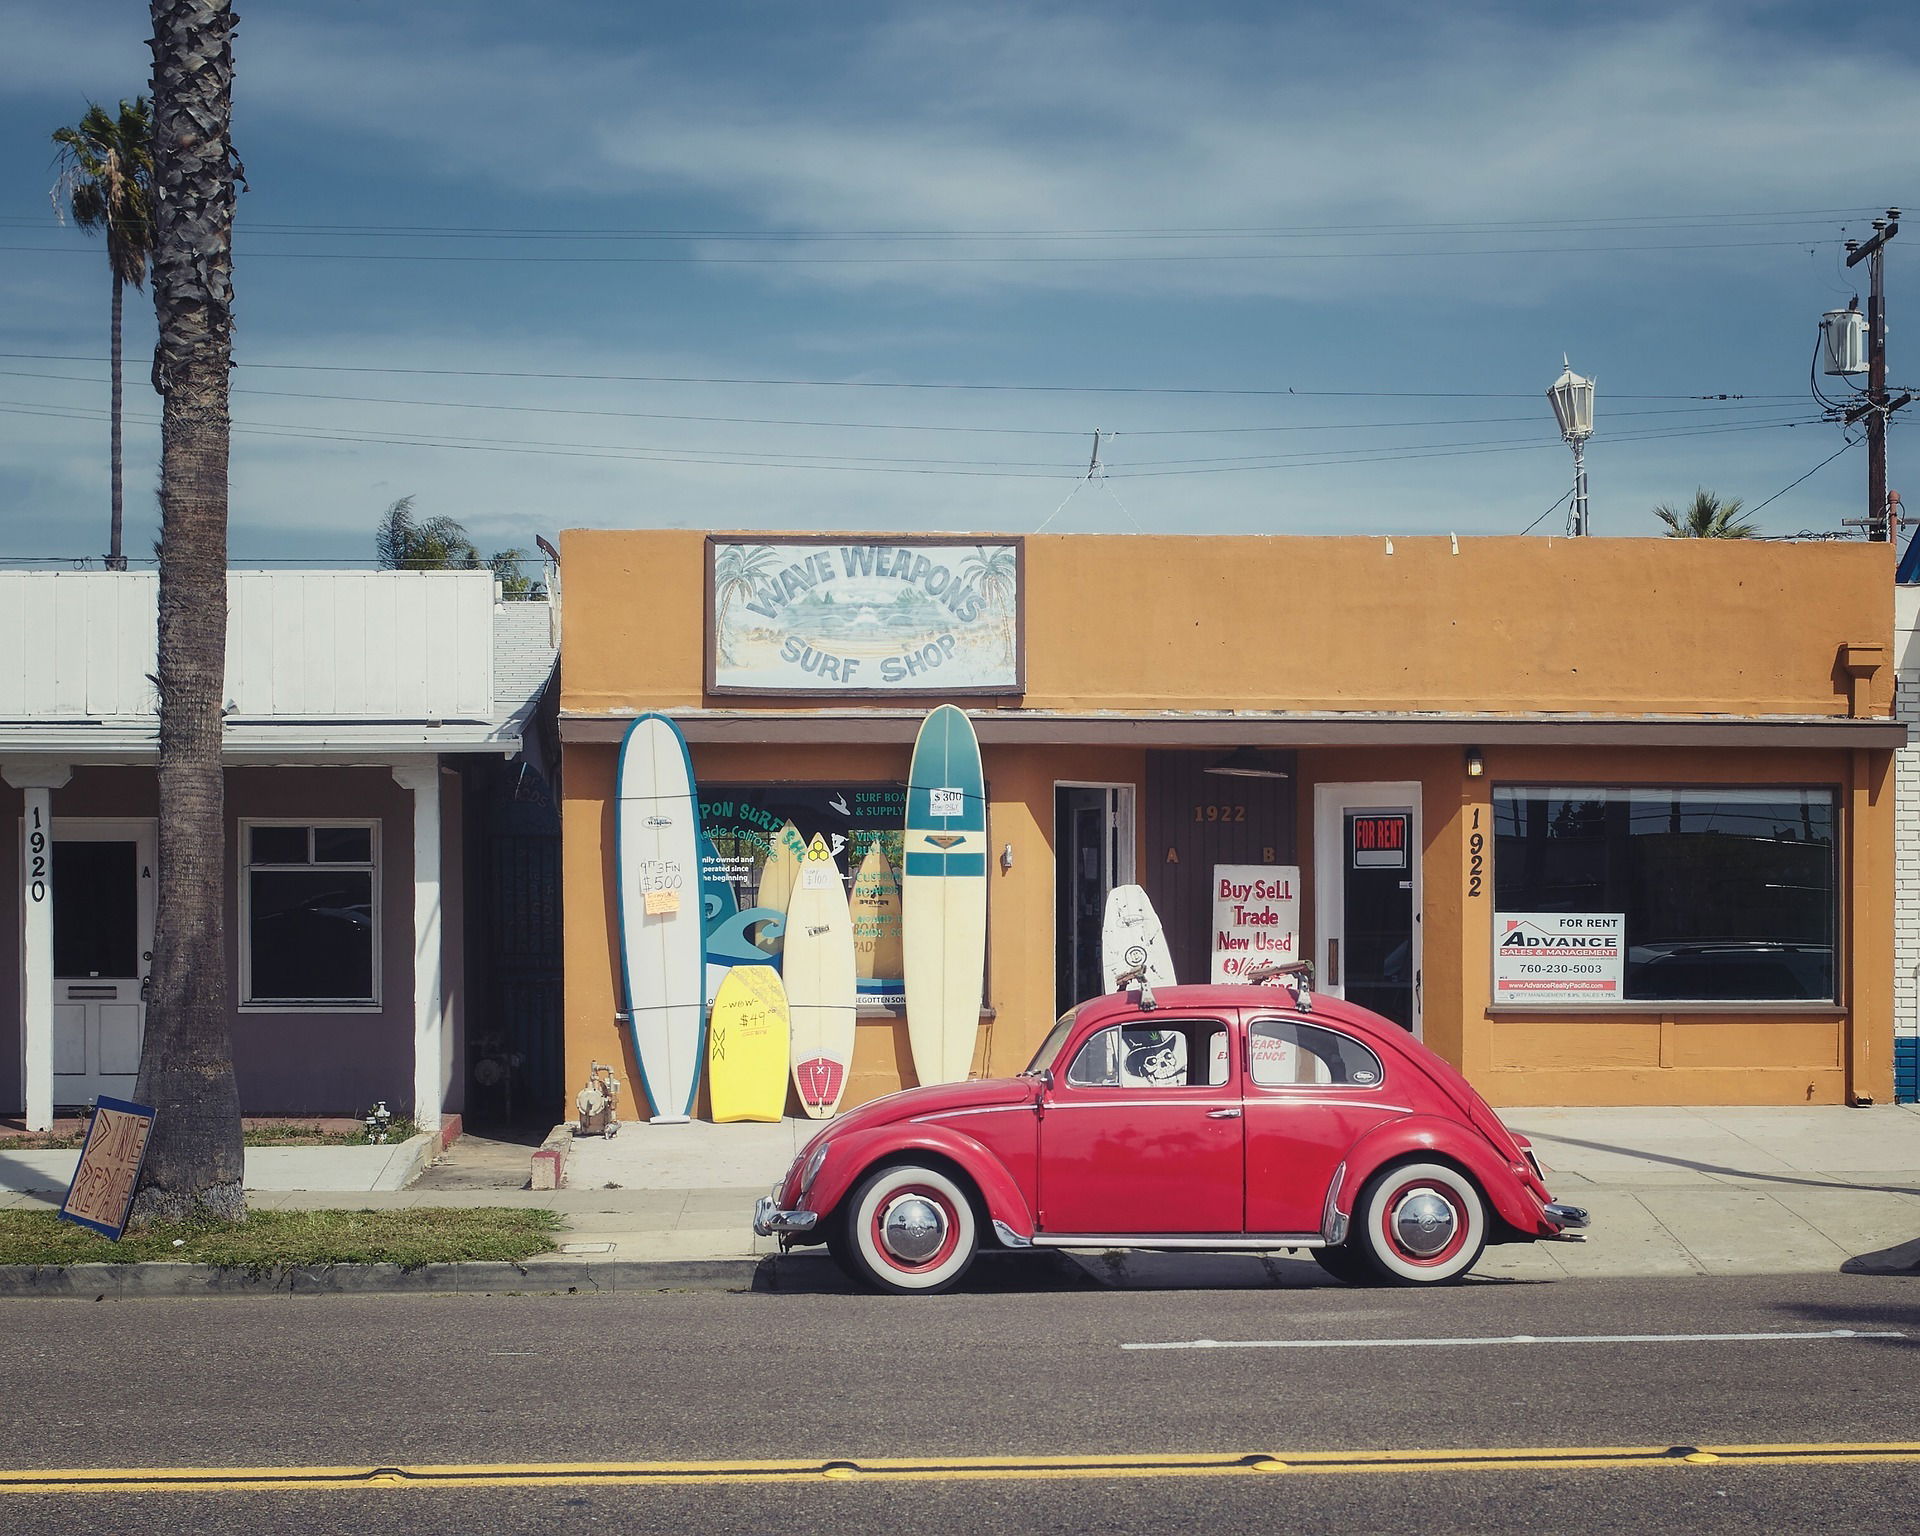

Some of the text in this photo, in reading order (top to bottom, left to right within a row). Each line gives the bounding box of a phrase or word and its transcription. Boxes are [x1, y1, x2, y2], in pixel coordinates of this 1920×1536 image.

[746, 545, 987, 623] WAVE WEAPONS
[780, 633, 956, 683] SURF SHOP
[855, 793, 905, 803] SURF BOA
[699, 801, 734, 820] PON
[740, 803, 785, 831] SURF
[856, 806, 904, 816] & SUPPLY
[1194, 805, 1246, 822] 1922
[702, 825, 728, 839] side
[1356, 820, 1404, 849] FOR RENT
[30, 806, 45, 903] 1920
[1166, 848, 1179, 863] A
[1263, 847, 1276, 862] B
[1468, 808, 1484, 897] 1922
[142, 866, 151, 879] A
[703, 866, 730, 874] perated
[643, 875, 682, 892] $500
[712, 874, 748, 883] beginning
[1220, 879, 1252, 902] Buy
[1233, 905, 1279, 925] Trade
[1559, 919, 1618, 928] FOR RENT
[1218, 931, 1292, 951] New Used
[1502, 931, 1617, 947] ADVANCE
[1546, 949, 1617, 957] MANAGEMENT
[1519, 964, 1602, 973] 760-230-5003
[1252, 1039, 1282, 1049] EARS
[68, 1159, 138, 1225] REPAIR
